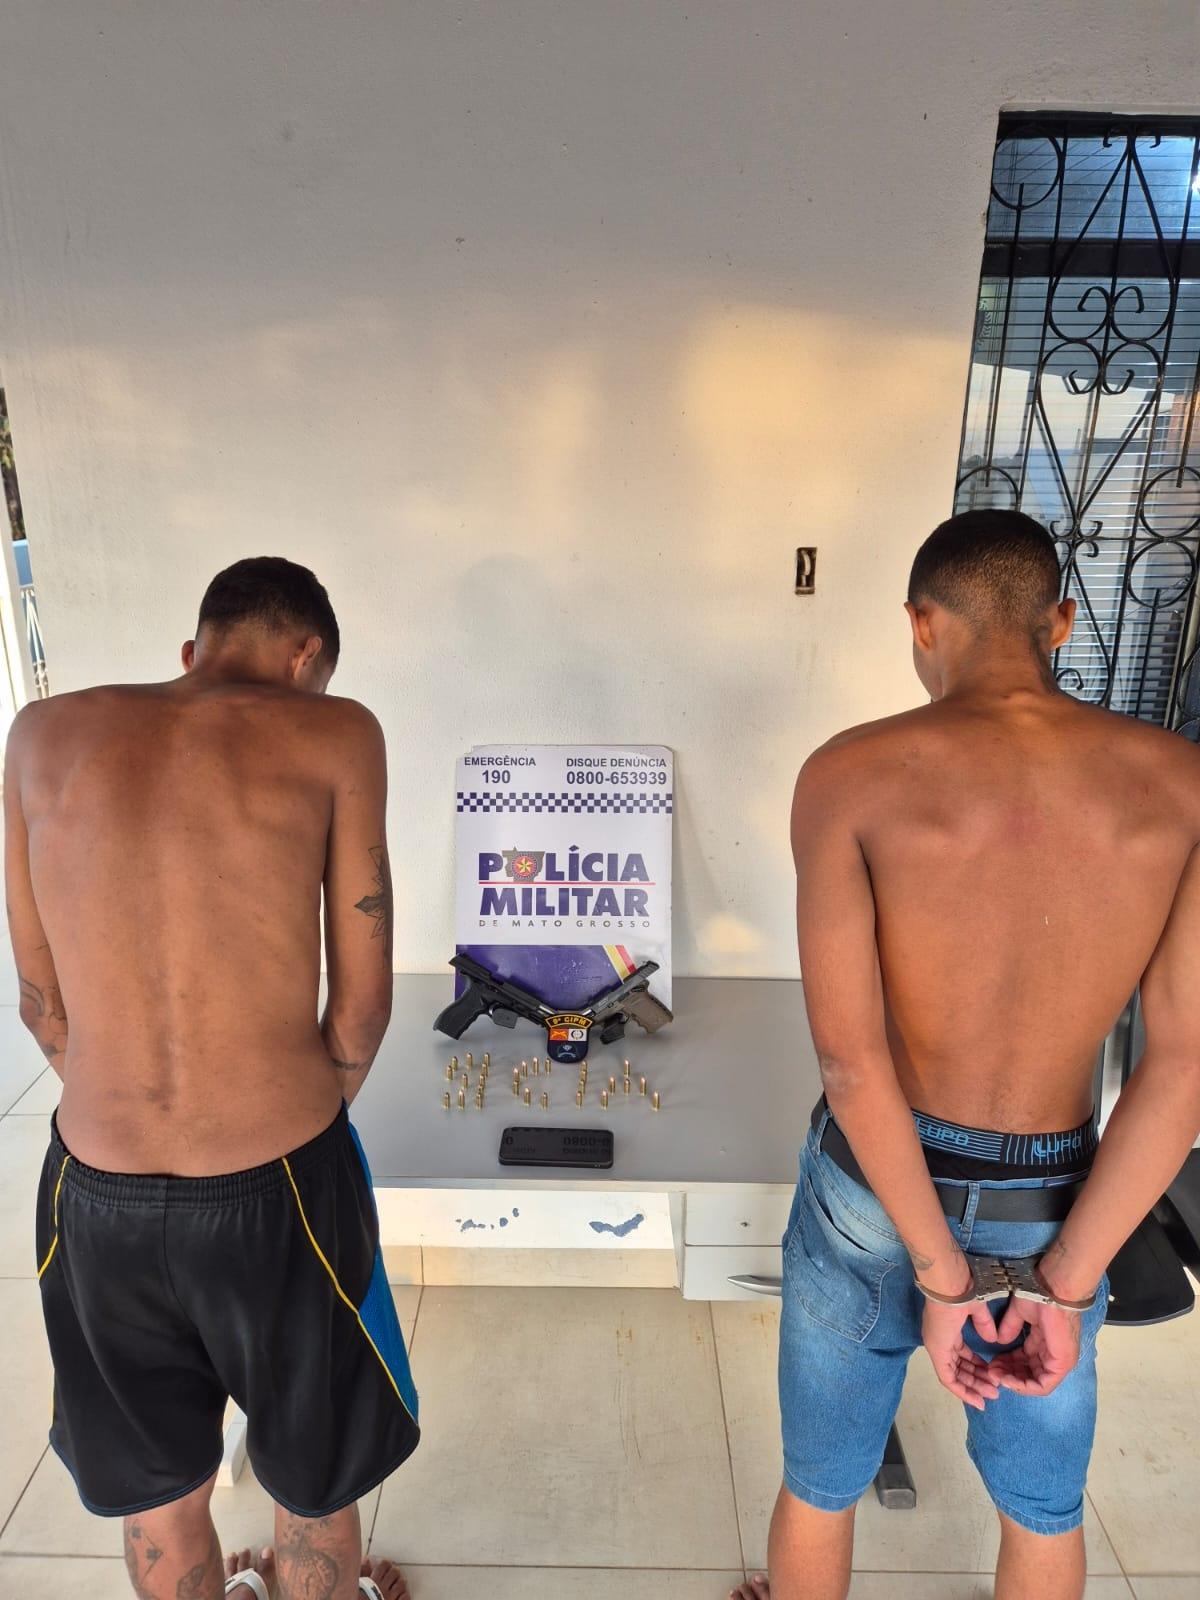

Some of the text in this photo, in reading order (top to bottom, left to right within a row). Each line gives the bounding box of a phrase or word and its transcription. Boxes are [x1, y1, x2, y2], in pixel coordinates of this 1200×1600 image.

[464, 755, 536, 767] EMERGÊNCIA
[566, 756, 667, 768] DISQUE DENÚNCIA
[482, 770, 511, 784] 190
[566, 771, 667, 785] 0800-653939
[480, 887, 650, 917] MILITAR
[479, 919, 650, 928] DE MATO GROSSO
